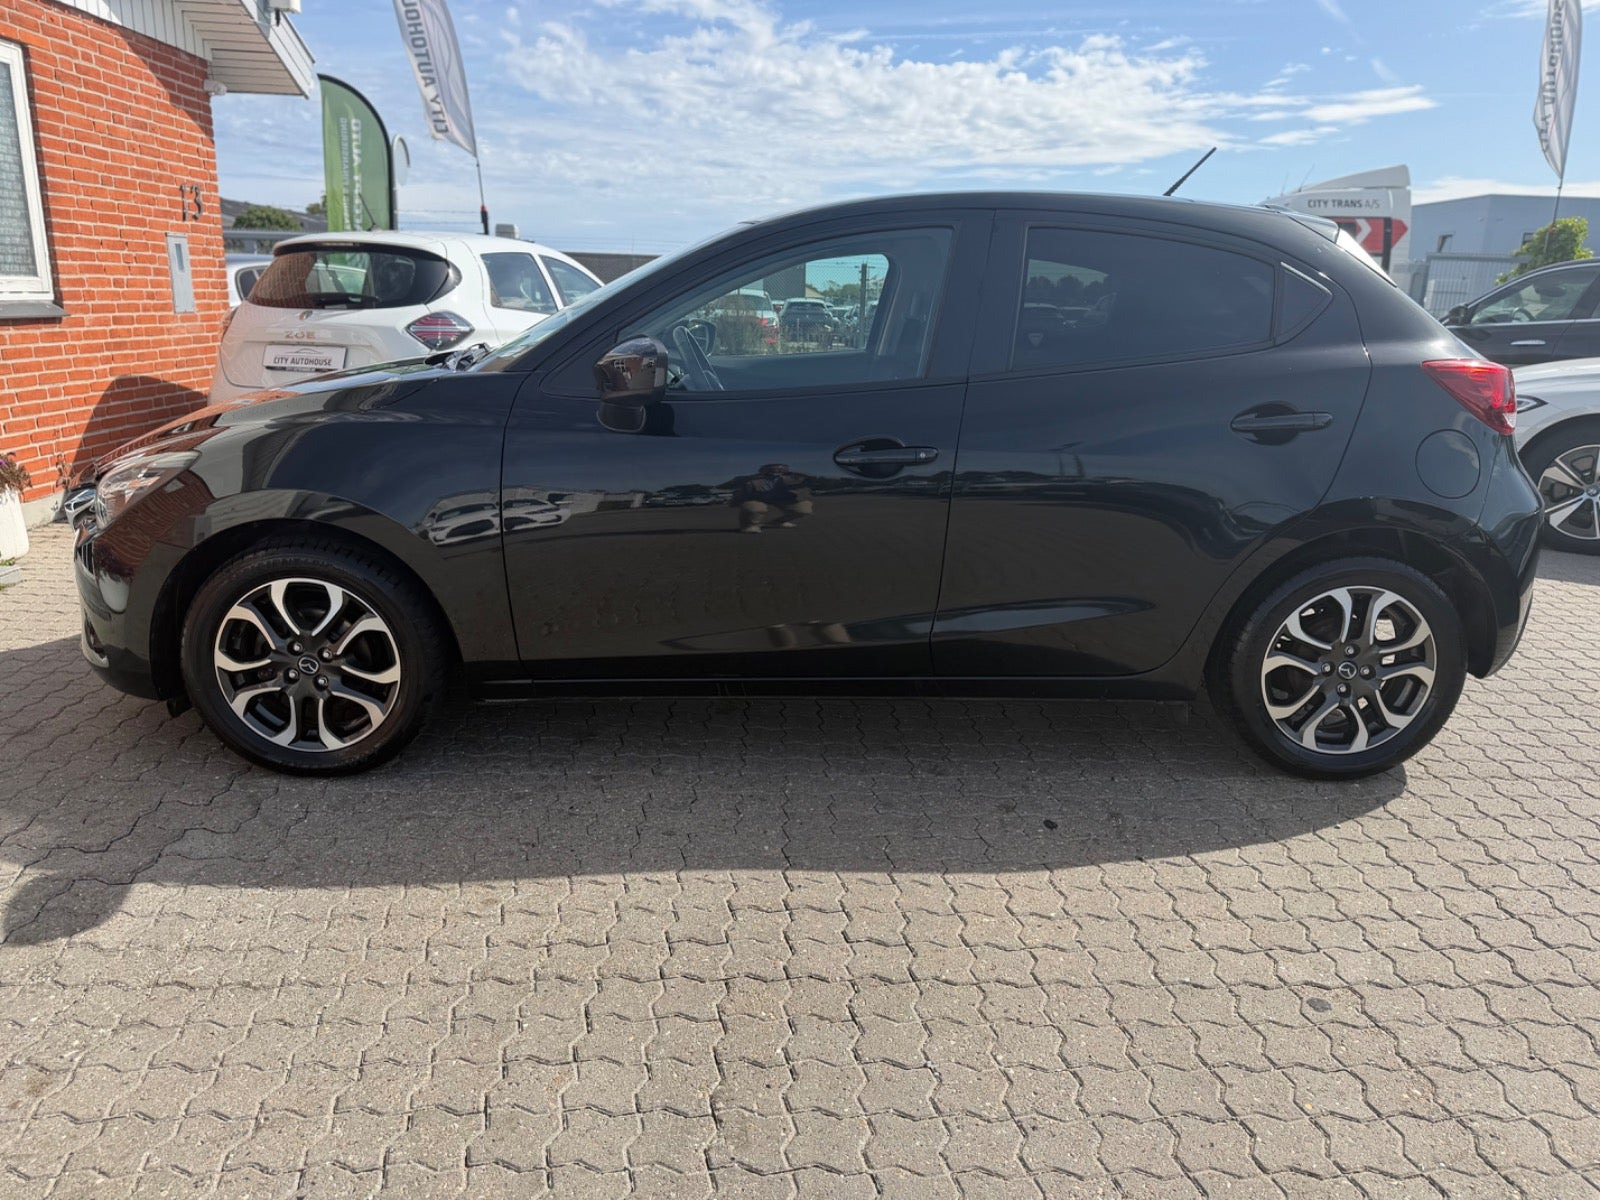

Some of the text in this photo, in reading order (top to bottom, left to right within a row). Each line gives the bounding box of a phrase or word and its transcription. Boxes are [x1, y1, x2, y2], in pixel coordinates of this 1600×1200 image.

[179, 182, 203, 222] 13
[1307, 199, 1380, 209] CITY TRANS A/S
[273, 356, 332, 366] CITY AUTOHOUSE
